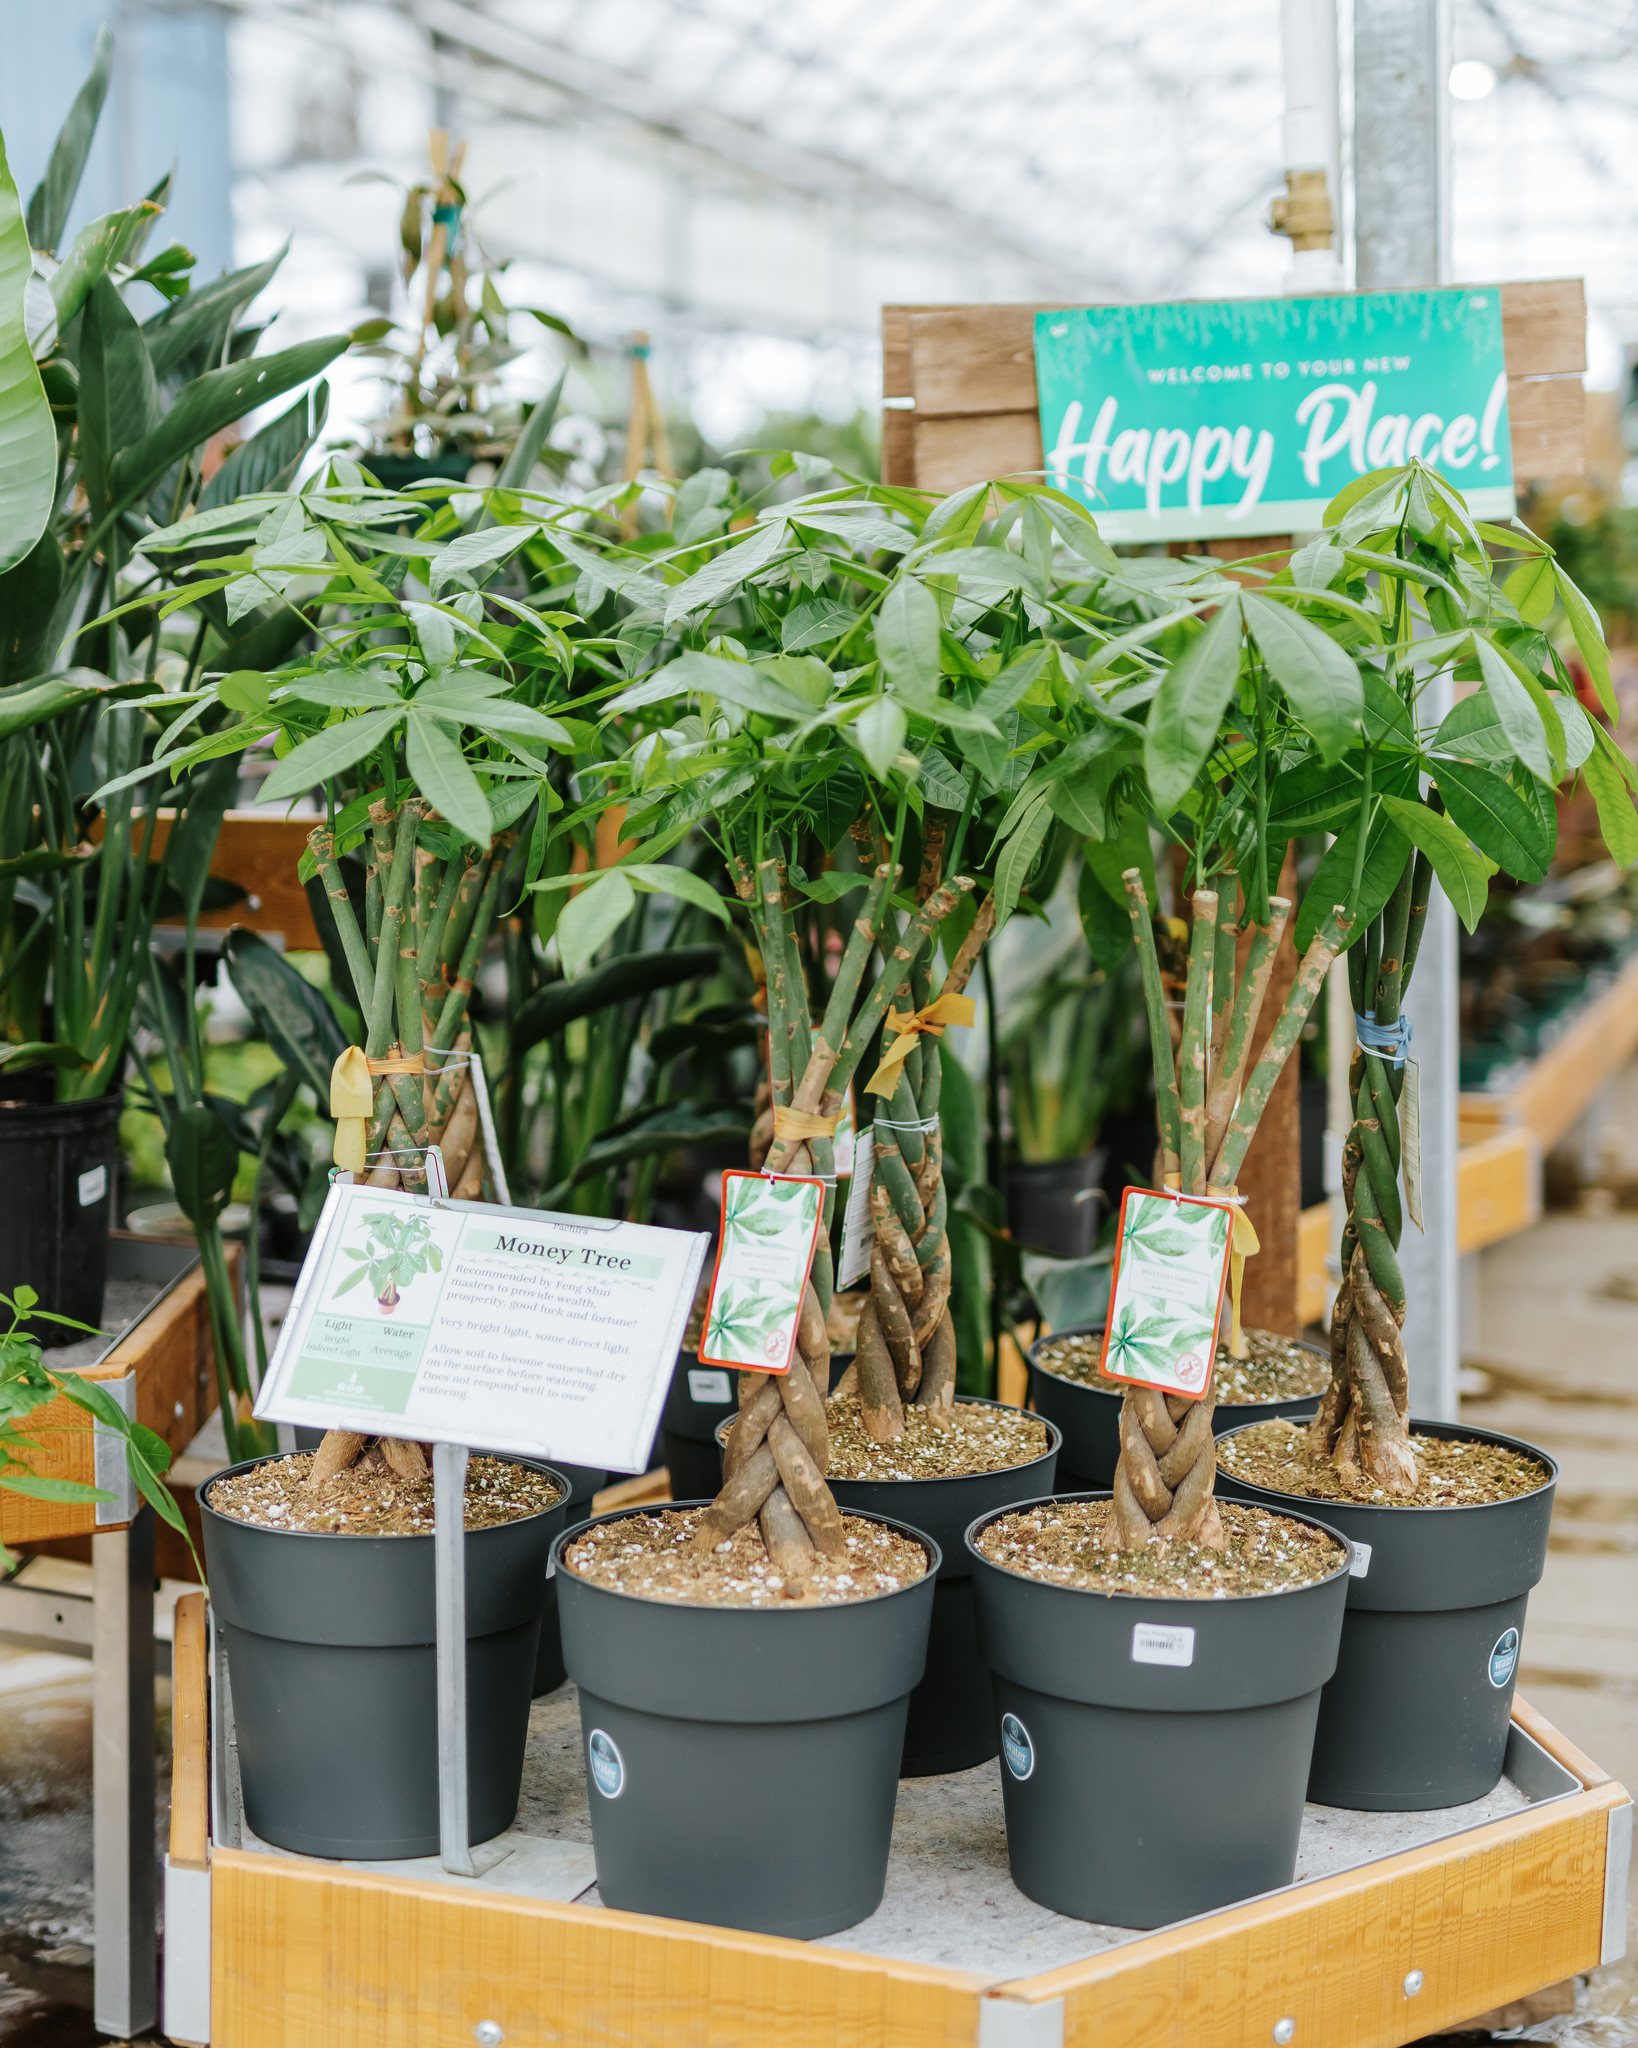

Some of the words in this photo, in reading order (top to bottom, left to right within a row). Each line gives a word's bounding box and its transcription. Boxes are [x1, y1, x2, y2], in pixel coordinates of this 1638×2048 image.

[1148, 363, 1253, 385] WELCOME
[1261, 362, 1291, 380] TO
[1297, 358, 1356, 378] YOUR
[1363, 355, 1411, 374] NEW
[1046, 396, 1275, 520] Happy
[1296, 371, 1508, 488] Place!
[553, 1223, 589, 1236] Pachira
[495, 1235, 574, 1265] Money
[581, 1248, 632, 1271] Tree
[451, 1278, 495, 1291] masters
[498, 1282, 509, 1293] to
[510, 1285, 554, 1301] provide
[557, 1293, 597, 1309] wealth,
[455, 1264, 537, 1285] Recommended
[539, 1273, 553, 1288] by
[555, 1276, 583, 1294] Feng
[585, 1282, 612, 1297] Shui
[446, 1291, 506, 1308] prosperity,
[508, 1298, 538, 1312] good
[540, 1303, 564, 1317] luck
[566, 1308, 588, 1321] and
[590, 1311, 638, 1328] fortune!
[324, 1319, 353, 1332] Light
[324, 1334, 350, 1345] Bright
[383, 1326, 416, 1339] Water
[439, 1316, 465, 1330] Very
[466, 1320, 500, 1336] bright
[503, 1325, 532, 1339] light,
[534, 1331, 566, 1344] some
[567, 1335, 600, 1350] direct
[603, 1341, 633, 1356] light.
[370, 1345, 413, 1360] Average
[431, 1344, 463, 1356] Allow
[464, 1347, 485, 1359] soil
[487, 1351, 499, 1361] to
[501, 1353, 544, 1368] become
[545, 1361, 604, 1379] somewhat
[606, 1369, 628, 1384] dry
[422, 1370, 449, 1382] Does
[452, 1374, 470, 1385] not
[473, 1377, 519, 1393] respond
[521, 1384, 545, 1396] well
[547, 1388, 559, 1399] to
[561, 1392, 588, 1403] over
[426, 1358, 441, 1367] on
[443, 1359, 461, 1370] the
[463, 1362, 505, 1376] surface
[506, 1367, 543, 1382] before
[545, 1373, 598, 1392] watering.
[418, 1385, 469, 1401] watering.
[1005, 1739, 1027, 1764] water
